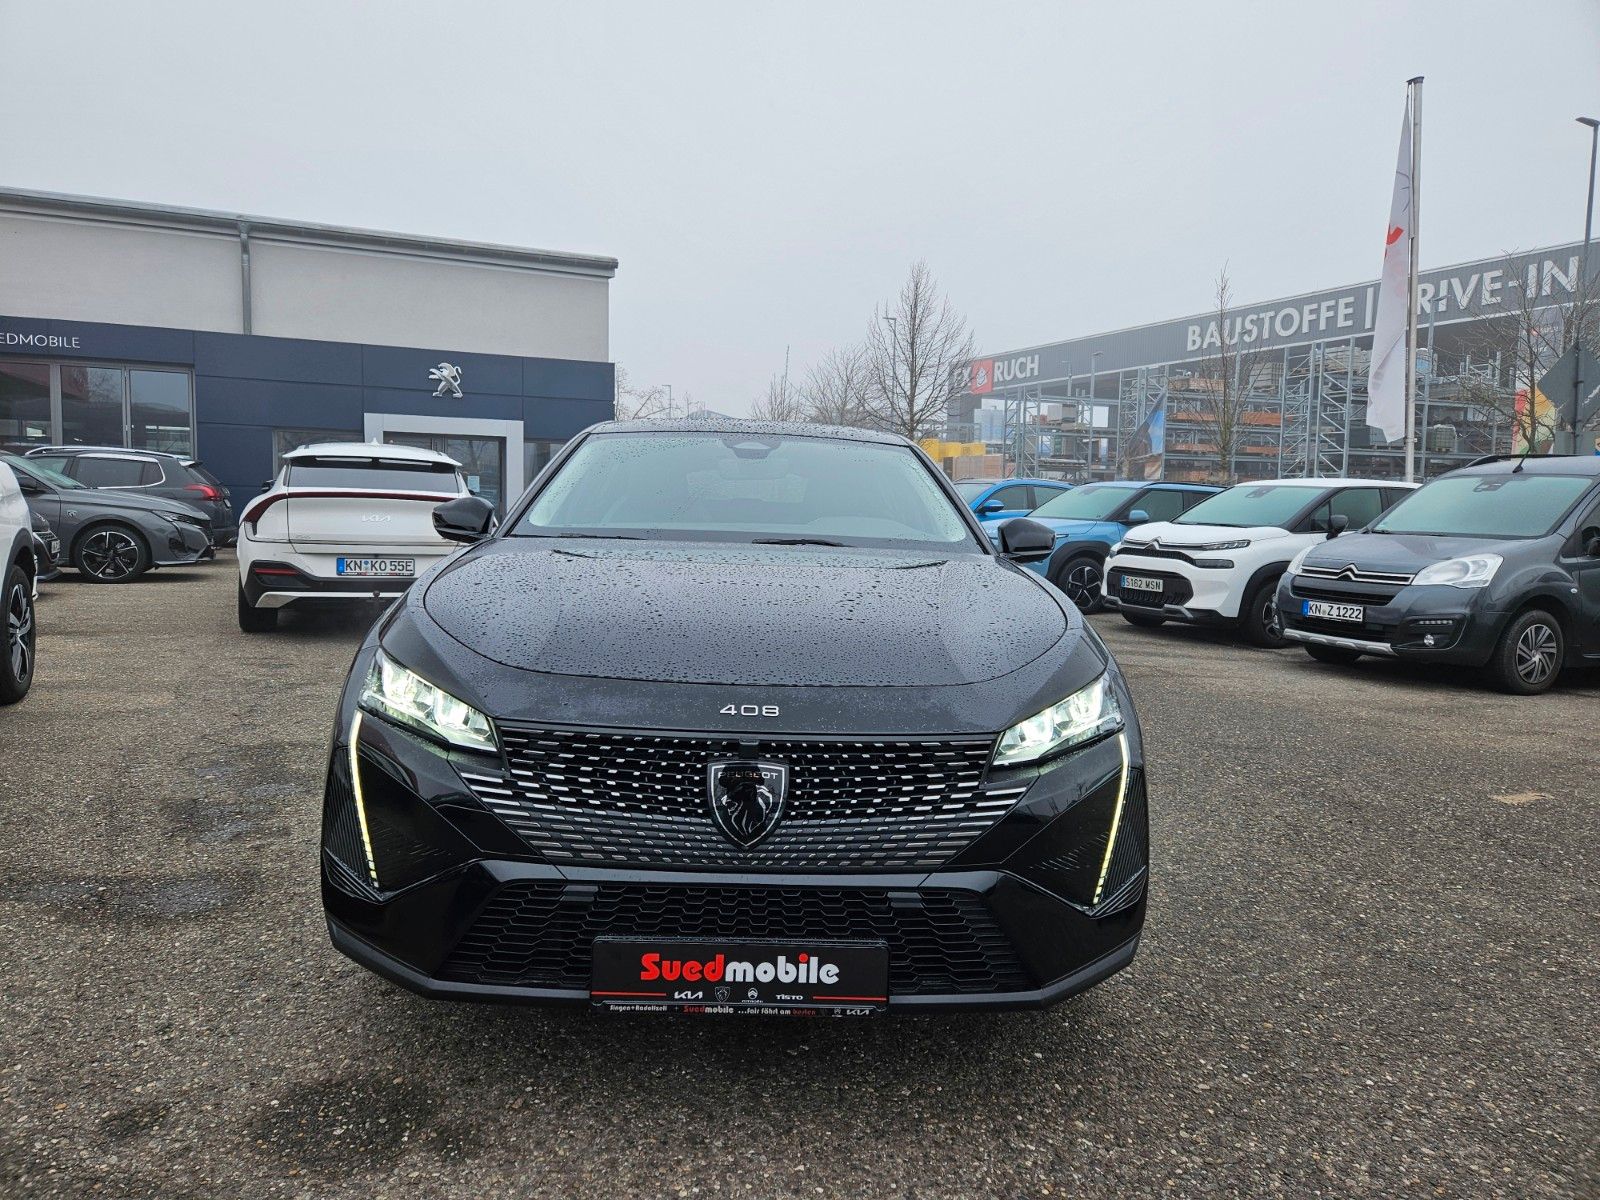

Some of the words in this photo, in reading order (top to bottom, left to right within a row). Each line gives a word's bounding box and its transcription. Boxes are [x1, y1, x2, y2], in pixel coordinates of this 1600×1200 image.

[1186, 296, 1356, 352] BAUSTOFFE
[1417, 256, 1580, 315] RIVE-IN
[994, 355, 1040, 383] RUCH
[345, 560, 362, 572] KN
[389, 561, 413, 572] 55E
[1308, 603, 1322, 615] KN
[1327, 605, 1334, 616] Z
[1335, 606, 1362, 619] 1222
[719, 704, 779, 717] 408
[640, 953, 840, 985] Suedmobile
[674, 990, 703, 999] KIA
